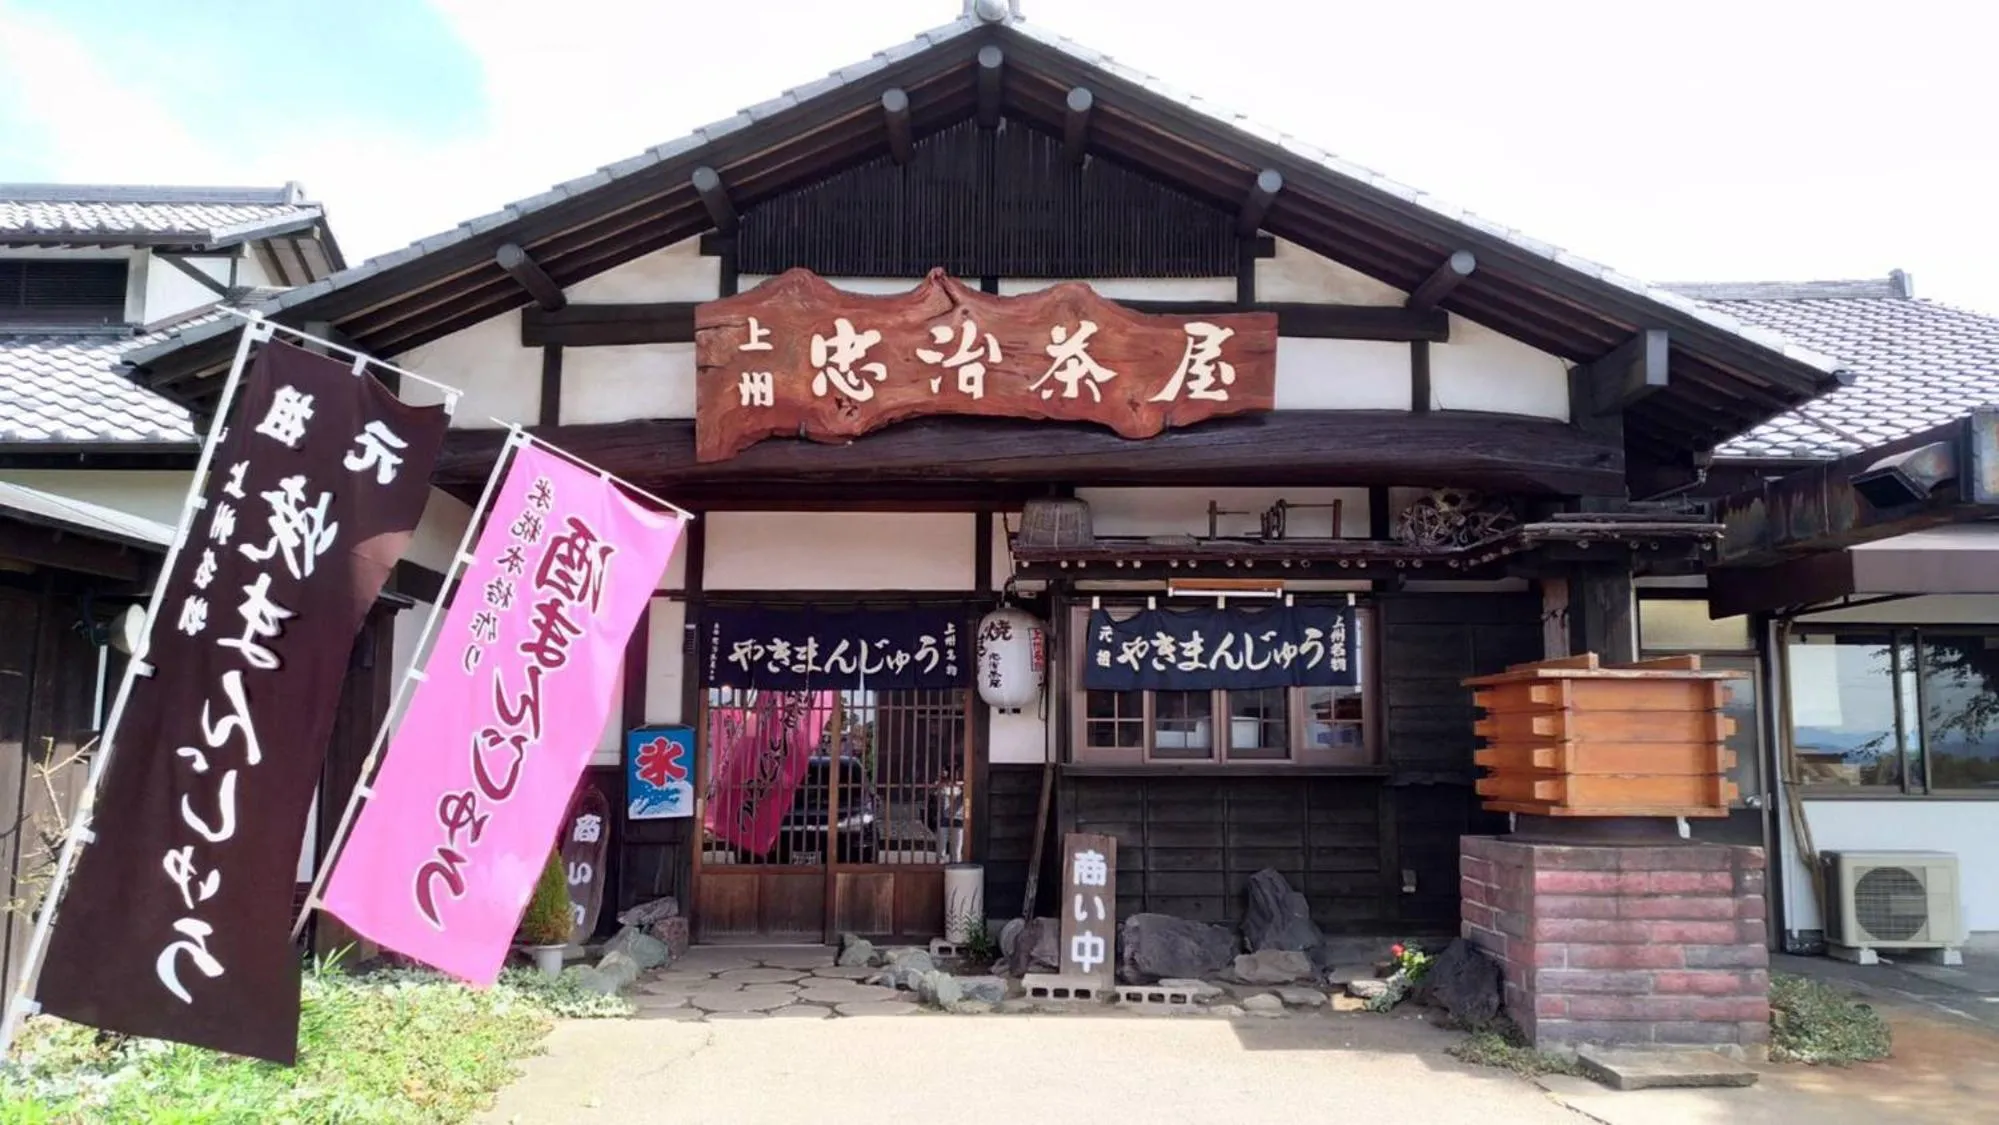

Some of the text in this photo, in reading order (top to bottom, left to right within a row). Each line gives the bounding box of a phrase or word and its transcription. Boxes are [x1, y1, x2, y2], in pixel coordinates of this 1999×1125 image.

[738, 316, 775, 407] 上州
[809, 317, 1238, 403] 忠治茶屋
[728, 634, 940, 675] やきまんじゅう
[1096, 625, 1114, 668] 元祖
[1116, 627, 1324, 672] やきまんじゅう
[636, 736, 688, 787] 氷
[1071, 849, 1108, 973] 商い中
